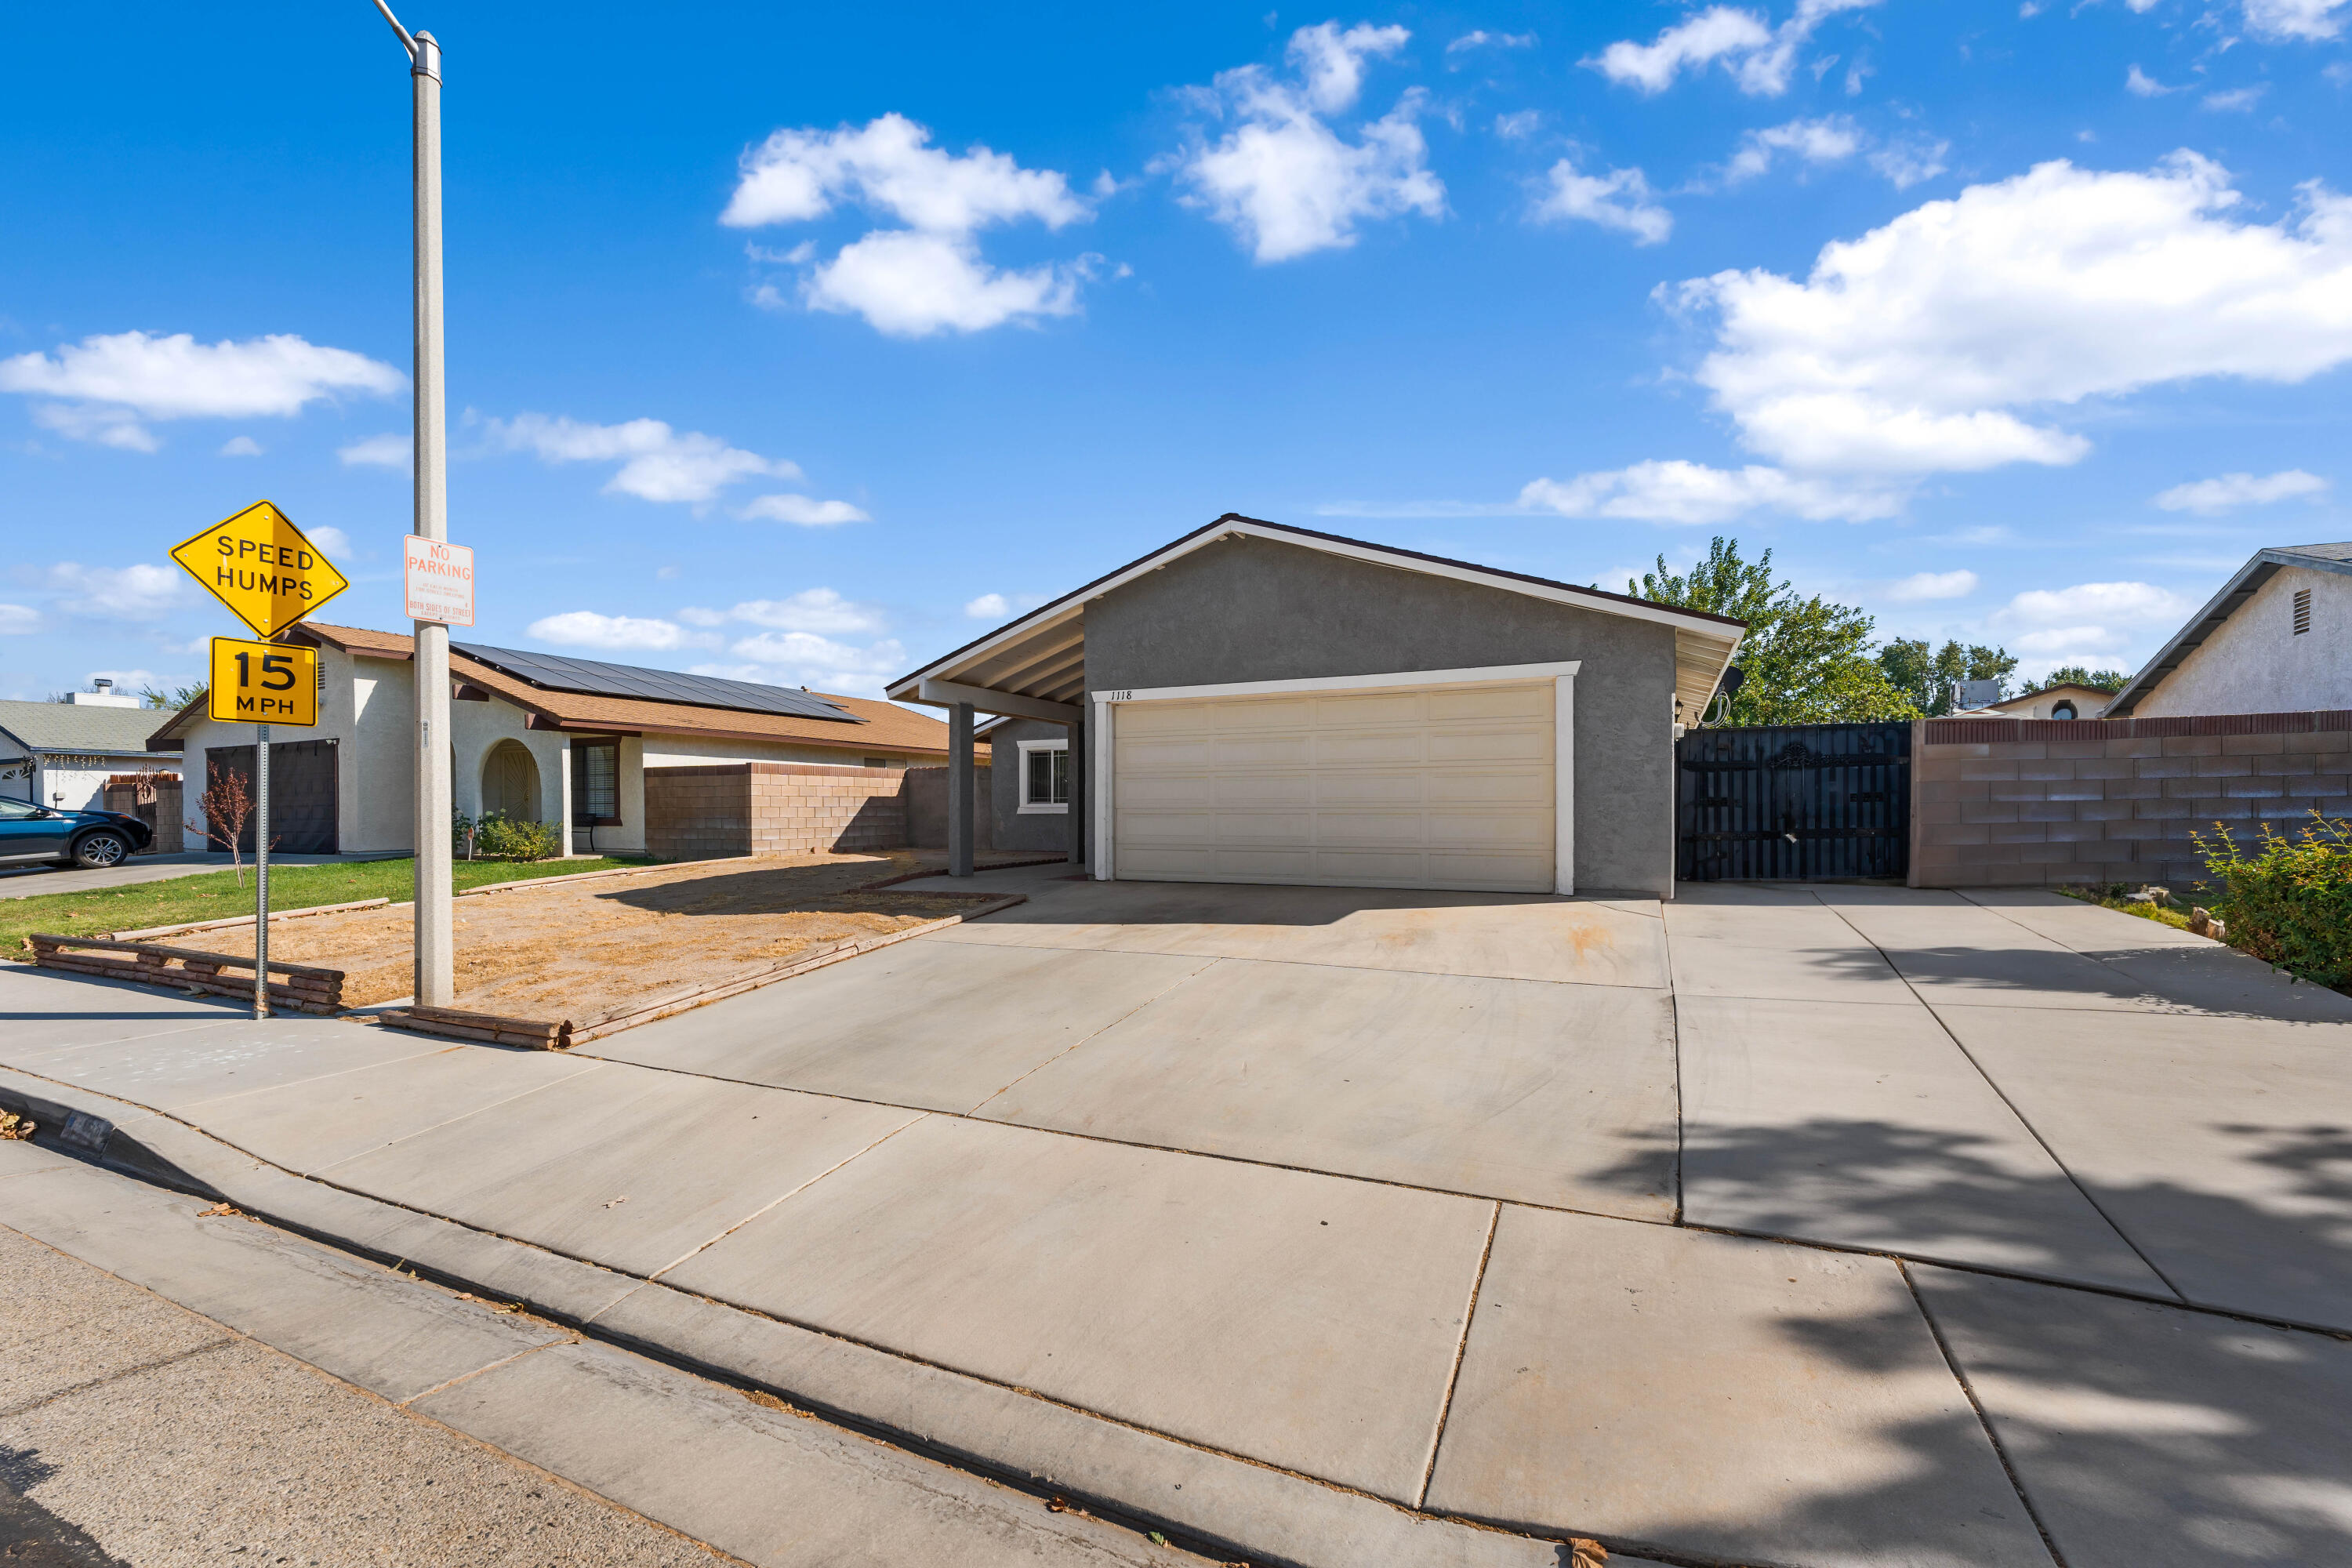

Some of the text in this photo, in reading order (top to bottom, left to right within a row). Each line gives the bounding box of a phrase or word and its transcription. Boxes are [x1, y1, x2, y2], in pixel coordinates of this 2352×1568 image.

[217, 535, 314, 570] SPEED
[430, 545, 450, 561] NO
[408, 557, 470, 580] PARKING
[217, 566, 313, 600] HUMPS
[409, 601, 424, 610] BOTH
[426, 603, 442, 614] SIDES
[452, 607, 470, 618] STREET
[234, 652, 296, 691] 15
[236, 695, 294, 714] MPH
[1111, 690, 1132, 700] 1118
